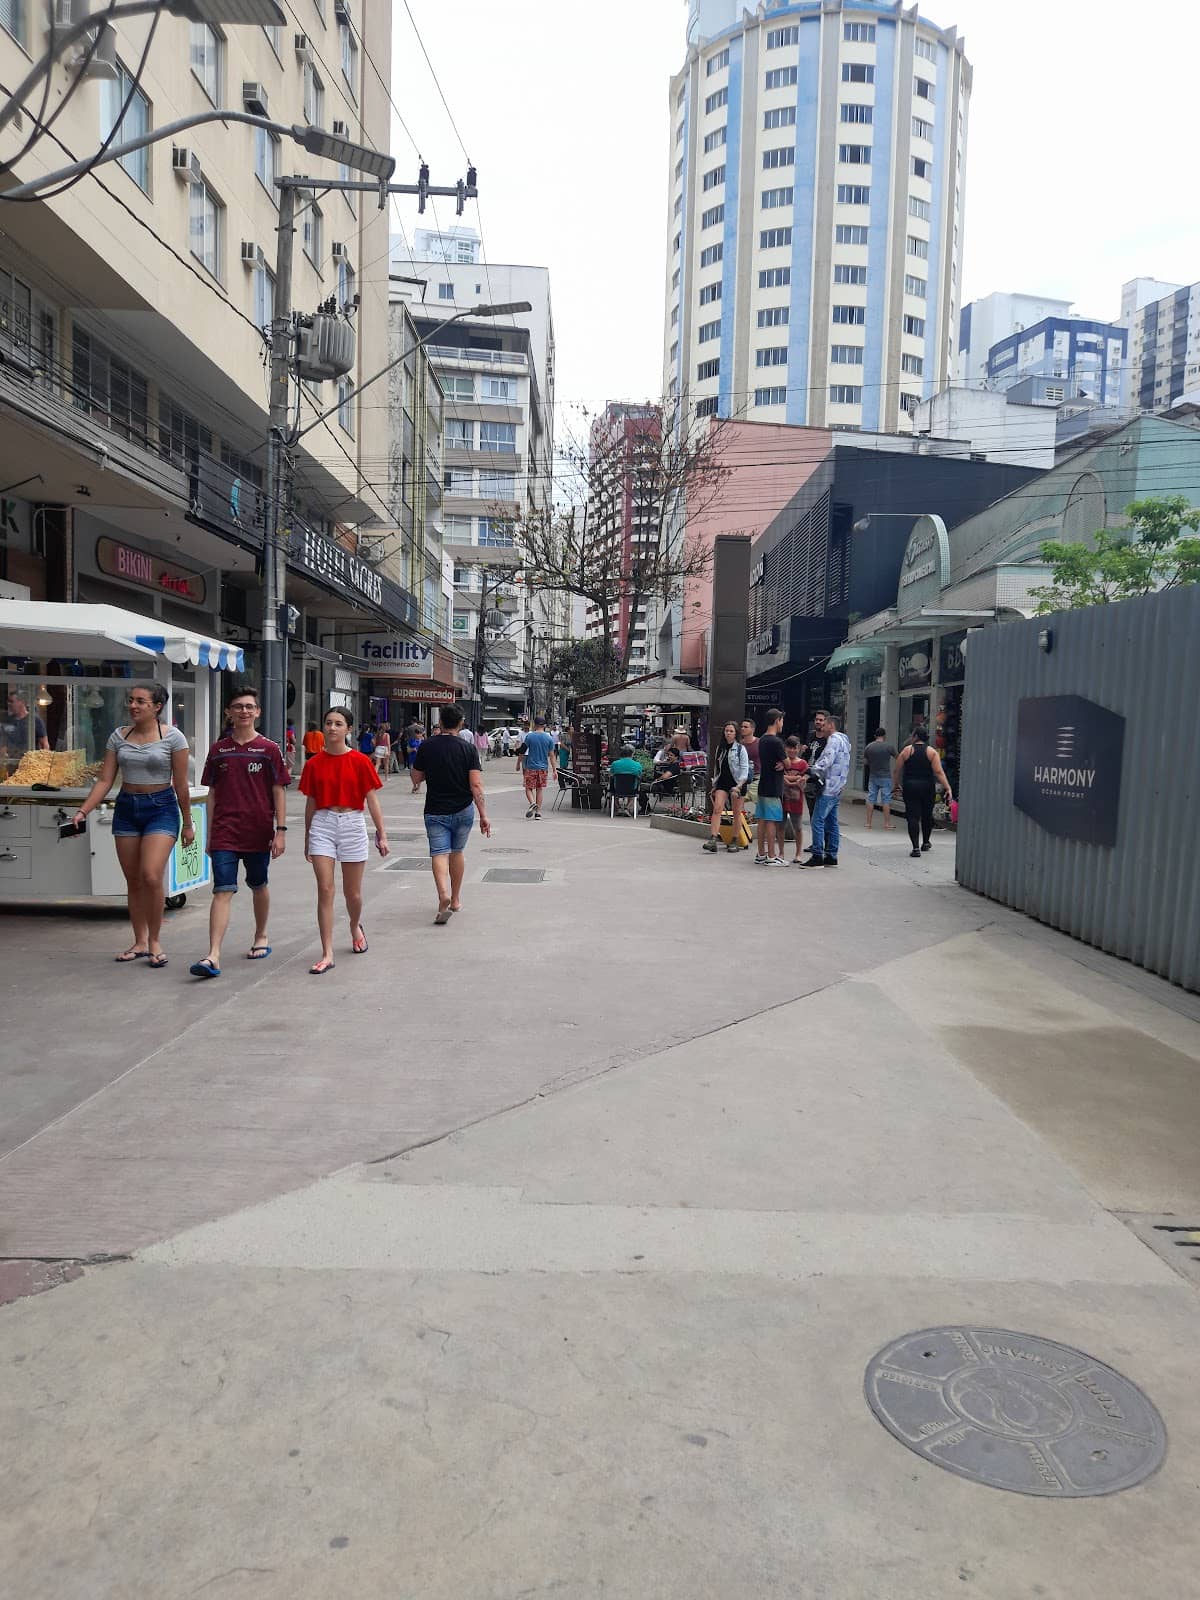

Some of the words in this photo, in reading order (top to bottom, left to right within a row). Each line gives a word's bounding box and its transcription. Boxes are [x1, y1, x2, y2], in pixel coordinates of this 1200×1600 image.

[304, 526, 346, 587] HOTEL
[349, 556, 383, 605] SAGRES
[361, 640, 432, 660] facility
[370, 660, 420, 669] supermercado
[391, 686, 453, 701] supermercado
[1034, 766, 1096, 788] HARMONY
[1041, 788, 1061, 797] OCEAN
[1063, 790, 1085, 799] FRONT
